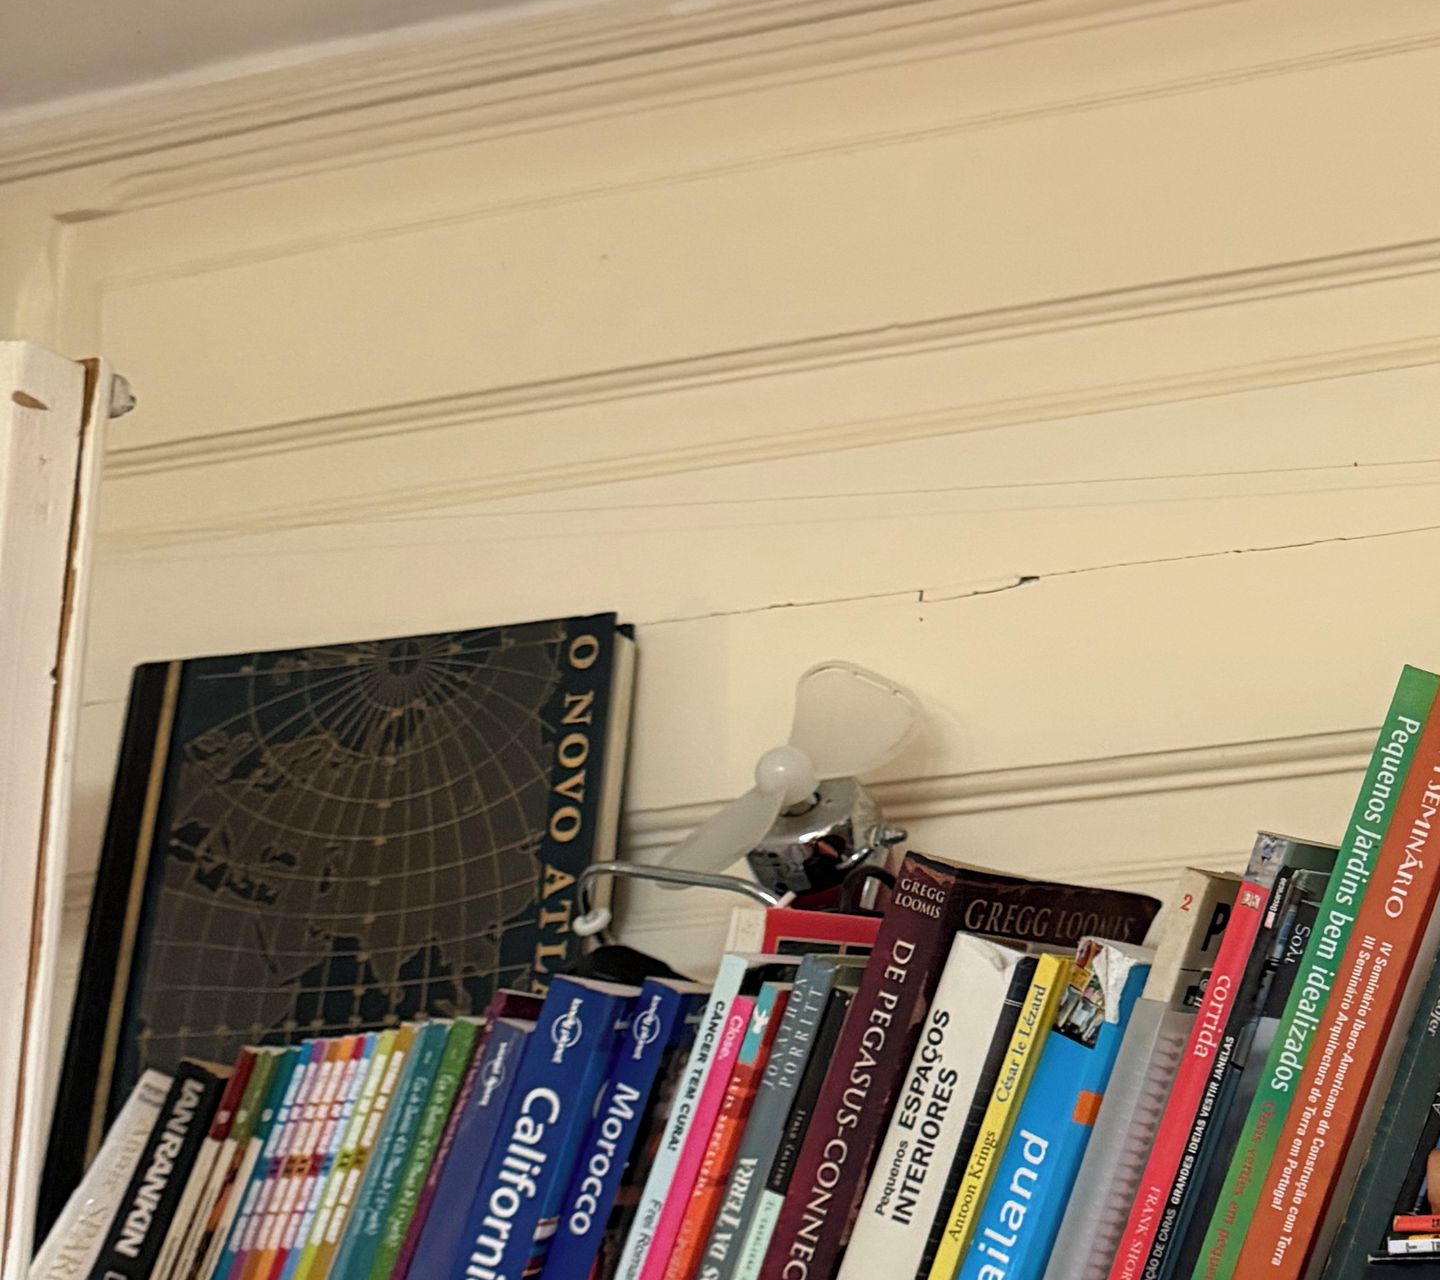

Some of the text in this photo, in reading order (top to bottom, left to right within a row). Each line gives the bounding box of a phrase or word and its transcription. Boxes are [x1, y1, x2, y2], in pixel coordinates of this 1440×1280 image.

[531, 634, 599, 997] O NOVO ATL
[894, 892, 942, 920] LOOMIS
[900, 878, 946, 904] GREGG
[1180, 894, 1194, 912] 2
[1270, 714, 1422, 1093] Pequenos Jardins bem idealizados
[964, 899, 1137, 943] GREGG LOOMIS
[884, 939, 916, 984] DE
[1381, 941, 1394, 957] IV
[1341, 950, 1370, 1011] Seminário
[1363, 957, 1388, 1017] Seminário
[778, 986, 823, 1088] PORRITT
[1193, 974, 1232, 1060] corrida
[996, 984, 1048, 1104] César le Lézard
[1213, 1035, 1237, 1080] JANELAS
[1313, 1010, 1350, 1087] Arquitectura
[1323, 1017, 1367, 1120] Ibero-Americano
[170, 1076, 206, 1134] IAN
[684, 1066, 705, 1100] TEM
[1199, 1079, 1221, 1121] VESTIR
[667, 1102, 692, 1153] CURA!
[875, 1007, 951, 1216] Pequenos ESPAÇOS
[1187, 1118, 1208, 1156] IDEIAS
[1298, 1104, 1319, 1138] Terra
[569, 1082, 640, 1236] Morocco
[891, 1067, 958, 1226] INTERIORES
[973, 1129, 1000, 1181] Krings
[1290, 1138, 1304, 1157] em
[1298, 1138, 1326, 1205] Construção
[114, 1131, 186, 1260] RANKIN
[720, 1157, 759, 1230] TERRA
[1170, 1154, 1195, 1206] GRANDES
[1271, 1157, 1298, 1213] Portugal
[642, 1198, 662, 1230] Frei
[1134, 1186, 1161, 1237] FRANK
[1157, 1208, 1178, 1246] CARAS
[1288, 1205, 1301, 1230] com
[710, 1232, 732, 1261] DA
[1152, 1240, 1167, 1259] DE
[1270, 1230, 1294, 1267] Terra
